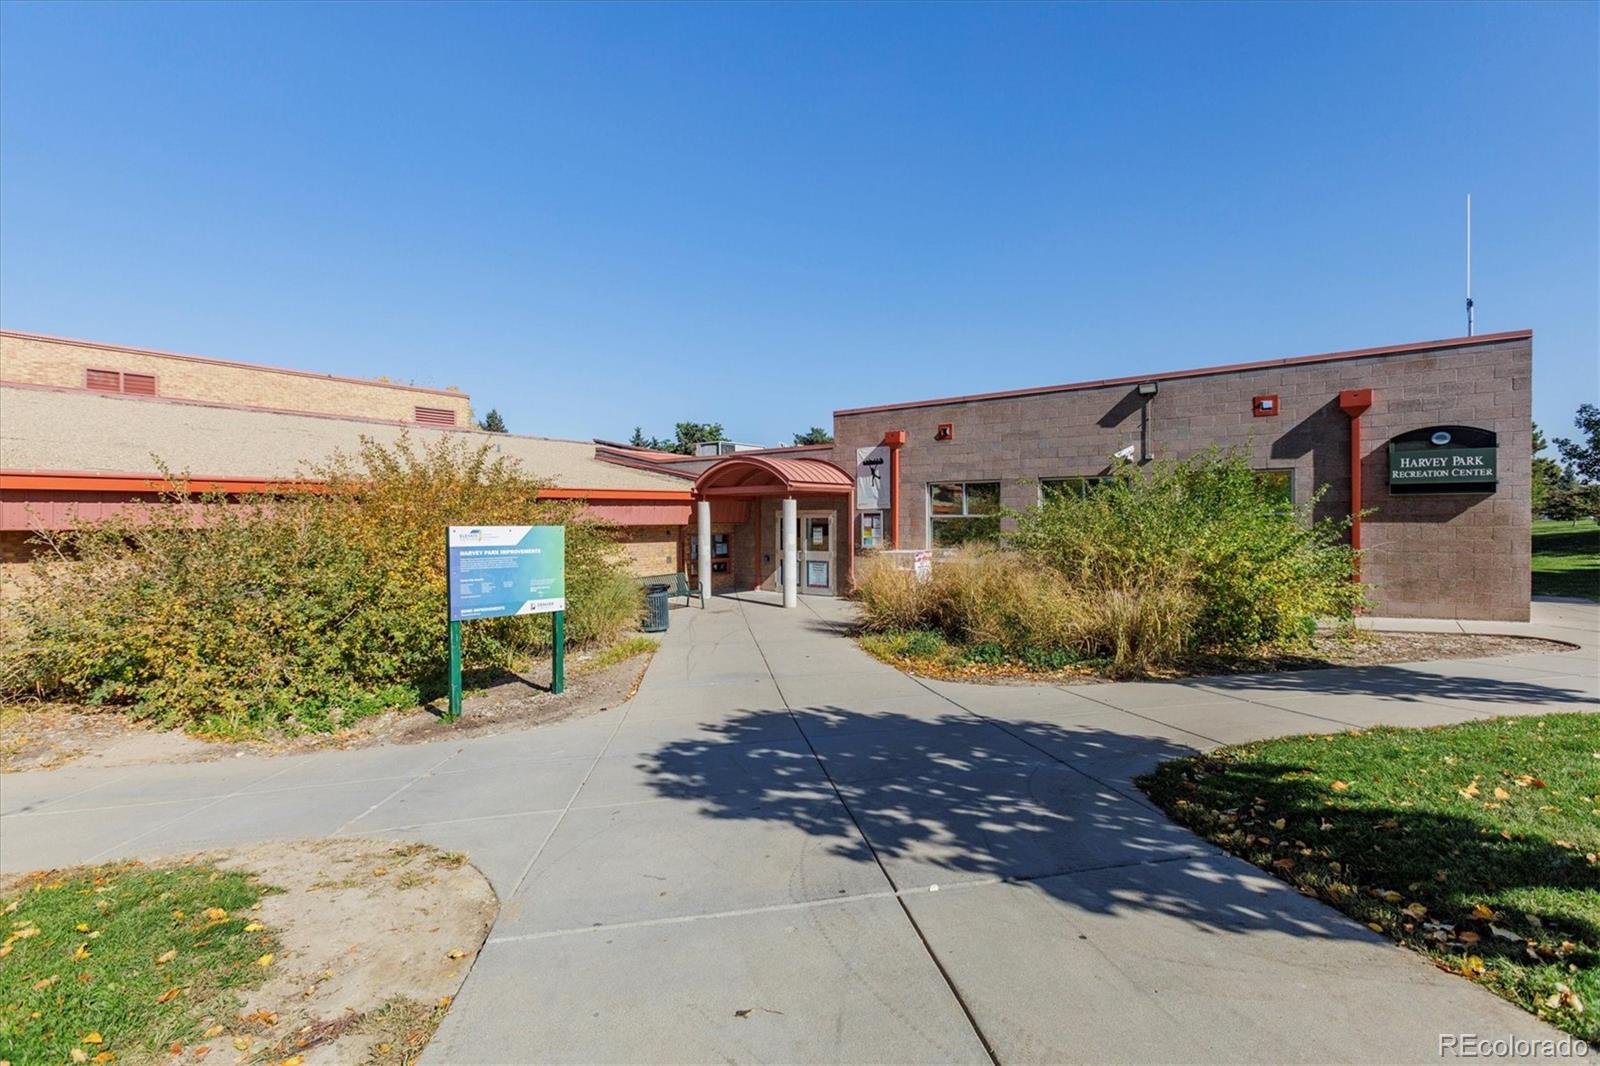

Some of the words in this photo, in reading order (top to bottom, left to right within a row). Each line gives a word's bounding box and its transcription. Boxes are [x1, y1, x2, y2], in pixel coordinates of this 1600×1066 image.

[1400, 457, 1448, 468] HARVEY
[1452, 455, 1485, 466] PARK
[1392, 469, 1449, 478] RECREATION
[1451, 468, 1493, 477] CENTER
